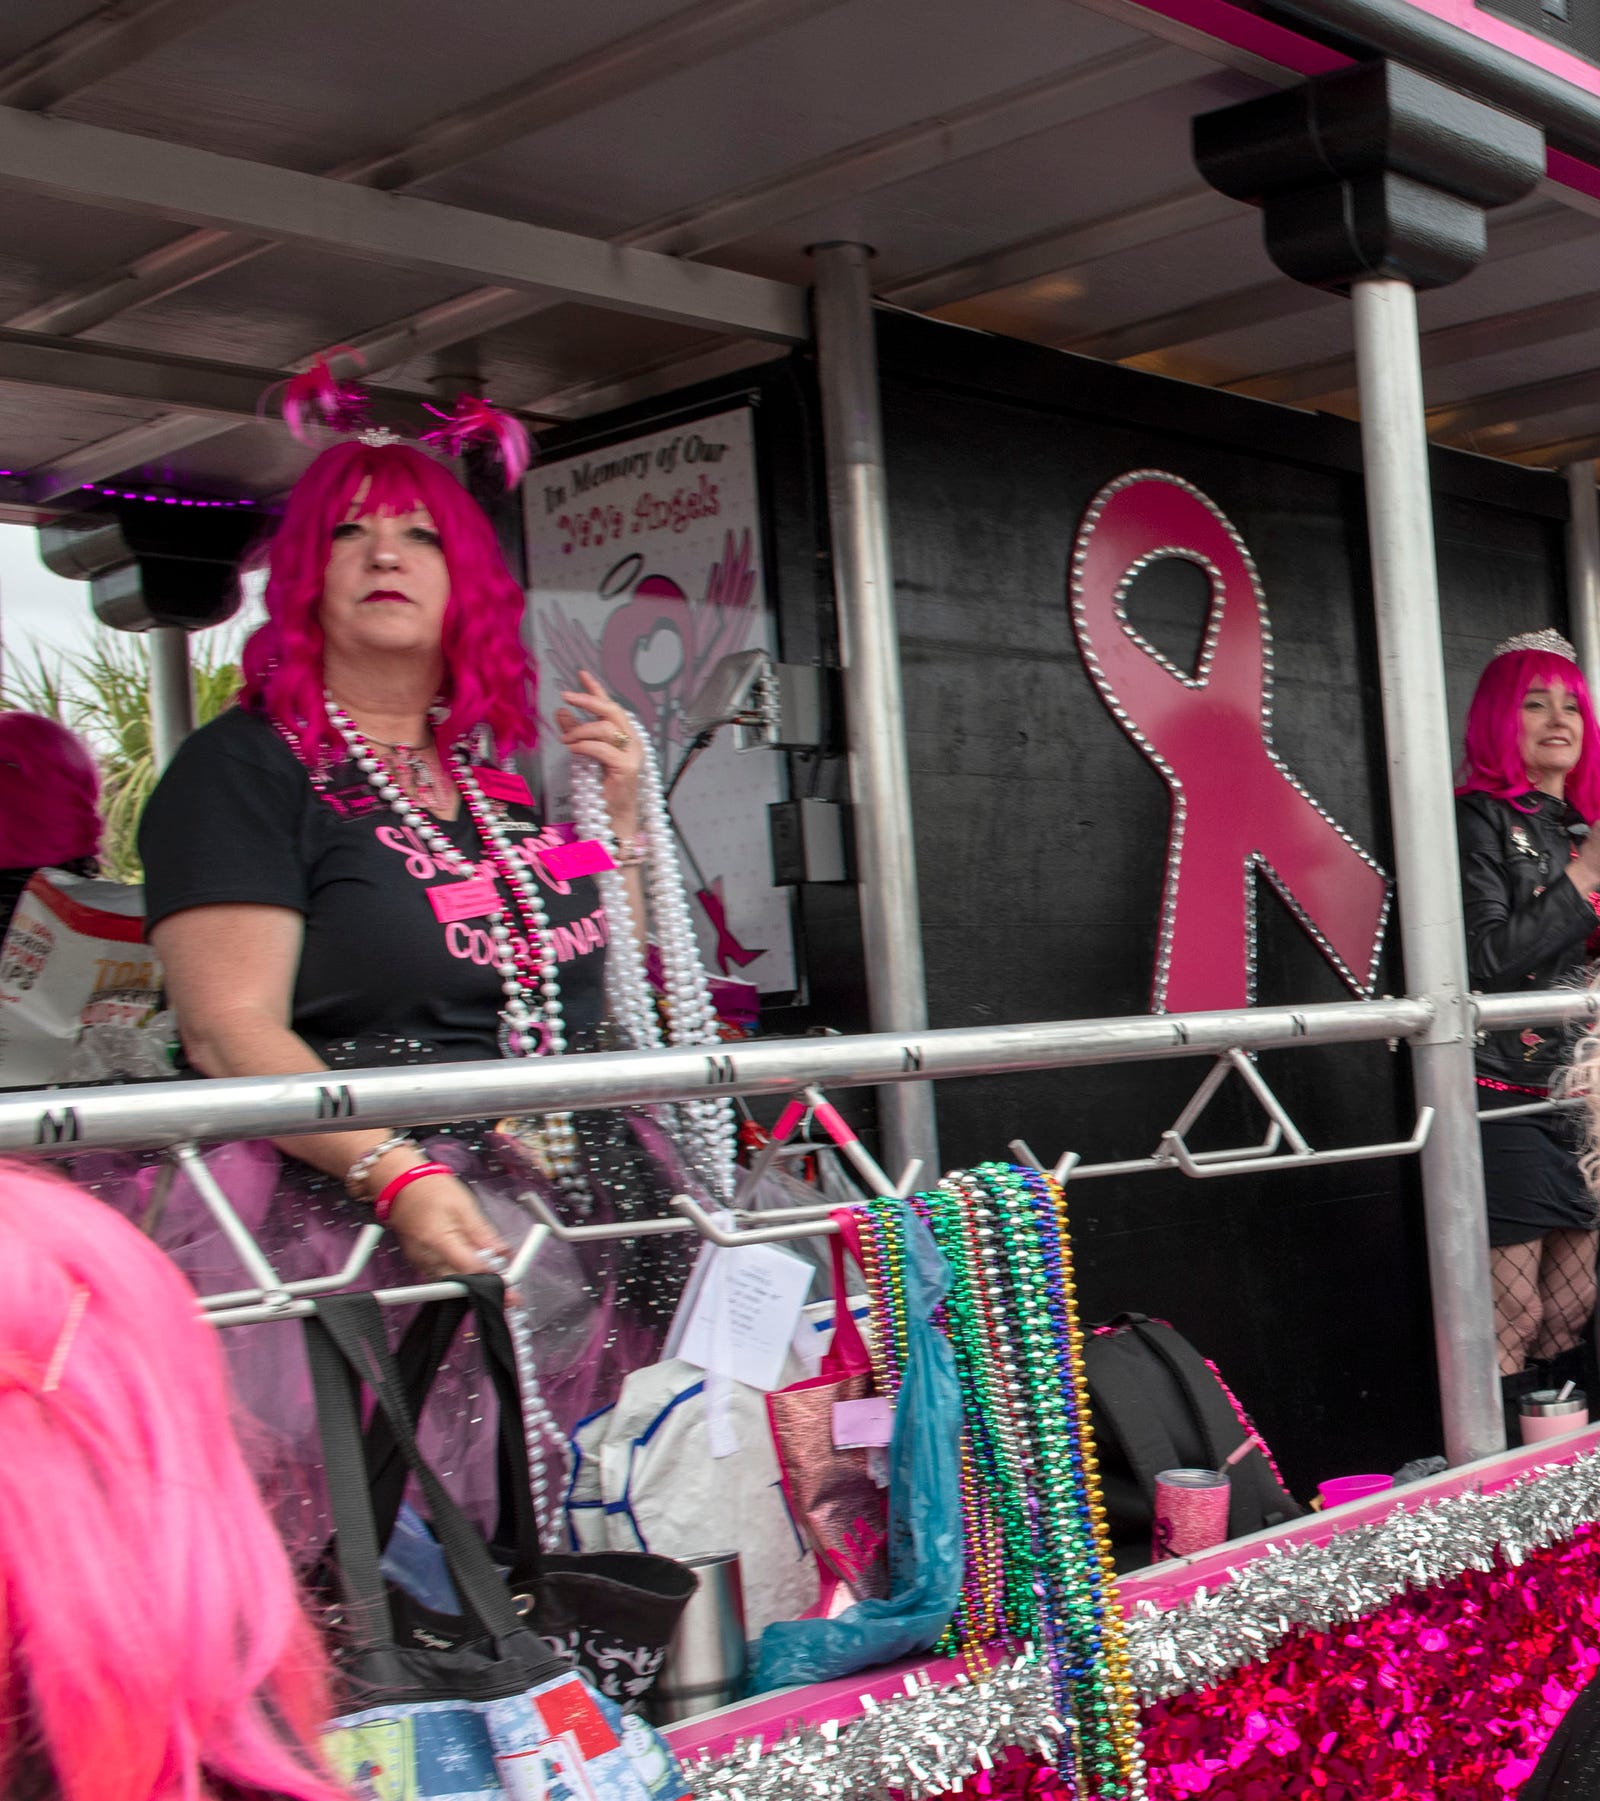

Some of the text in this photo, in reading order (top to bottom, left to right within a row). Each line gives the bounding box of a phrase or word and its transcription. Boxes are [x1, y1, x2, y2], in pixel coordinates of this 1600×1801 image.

[570, 461, 652, 498] Memory
[655, 436, 684, 474] of
[683, 434, 729, 464] Our
